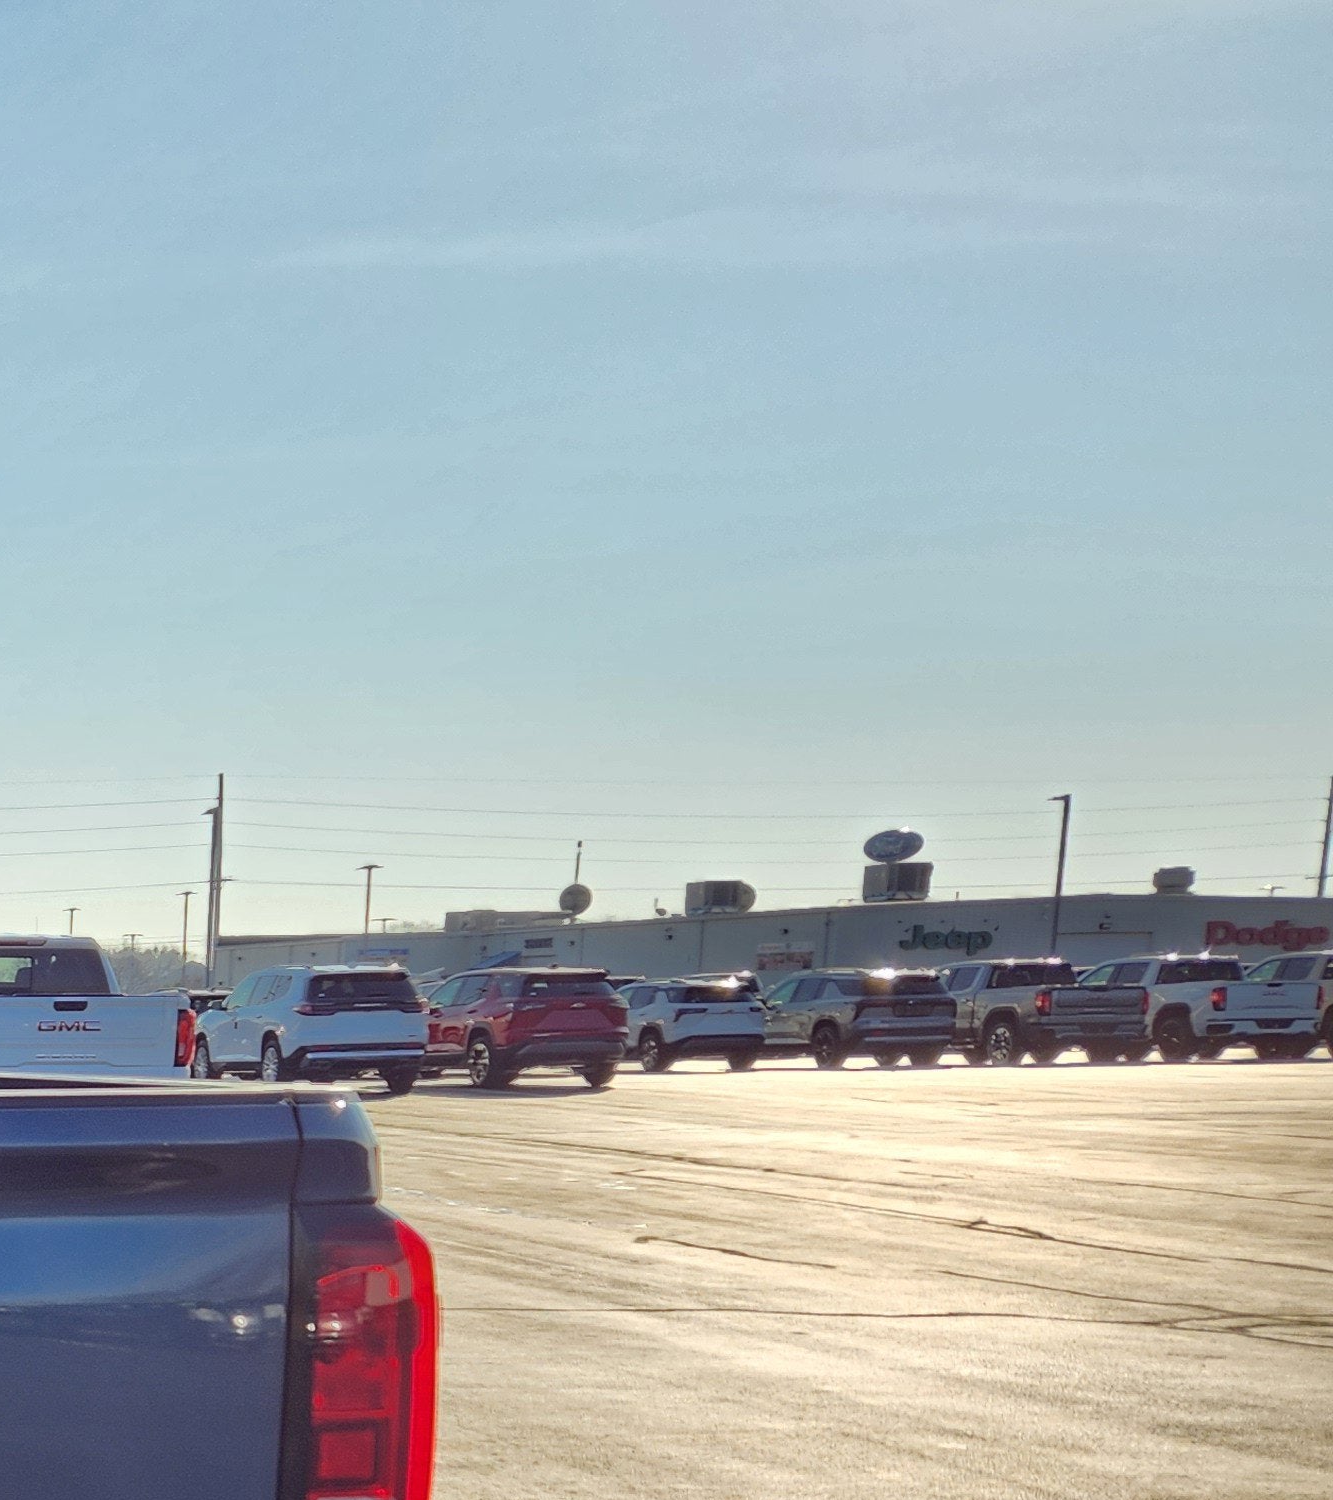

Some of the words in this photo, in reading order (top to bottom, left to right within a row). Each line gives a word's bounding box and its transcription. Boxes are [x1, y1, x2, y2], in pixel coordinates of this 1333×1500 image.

[899, 924, 993, 956] Jeep
[1205, 920, 1330, 951] Dodge
[38, 1020, 101, 1032] GMC
